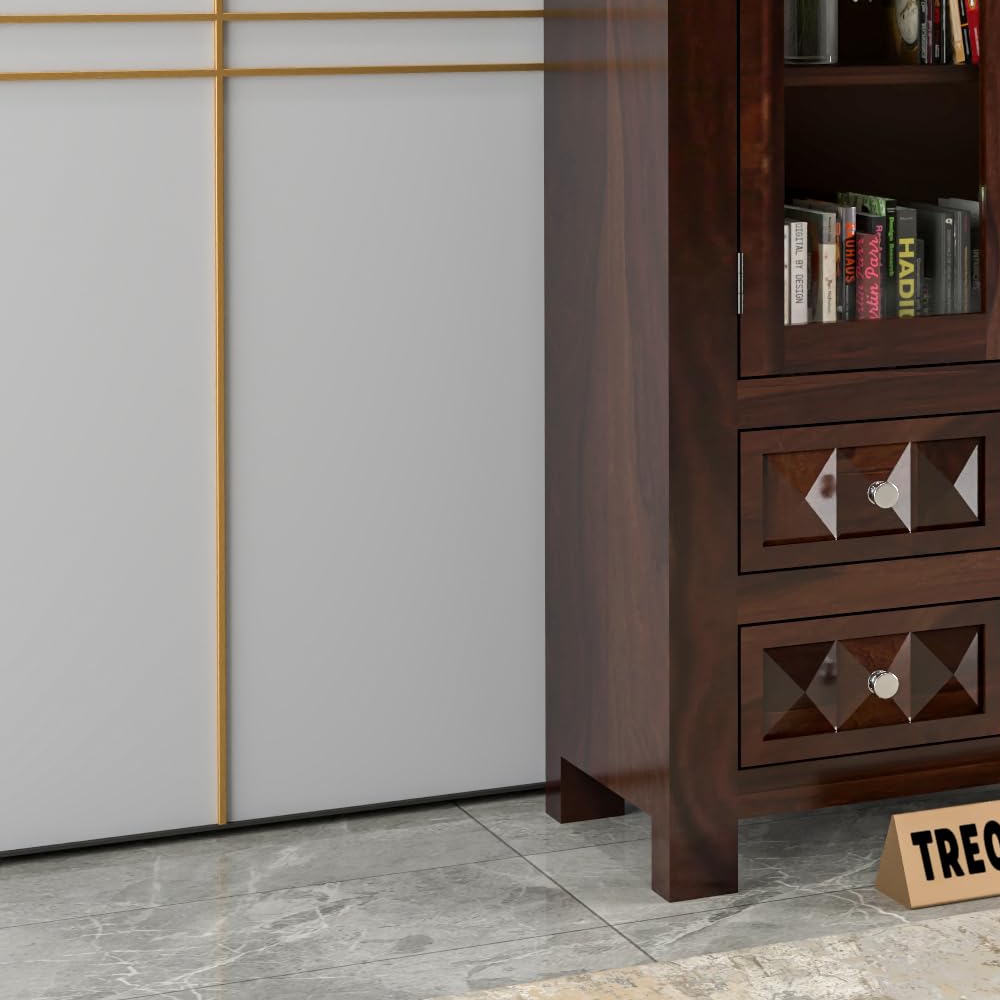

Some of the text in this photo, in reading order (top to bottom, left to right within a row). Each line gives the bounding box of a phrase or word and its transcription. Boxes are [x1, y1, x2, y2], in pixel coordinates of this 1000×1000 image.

[795, 224, 803, 304] DIGITAL BY DESIGN
